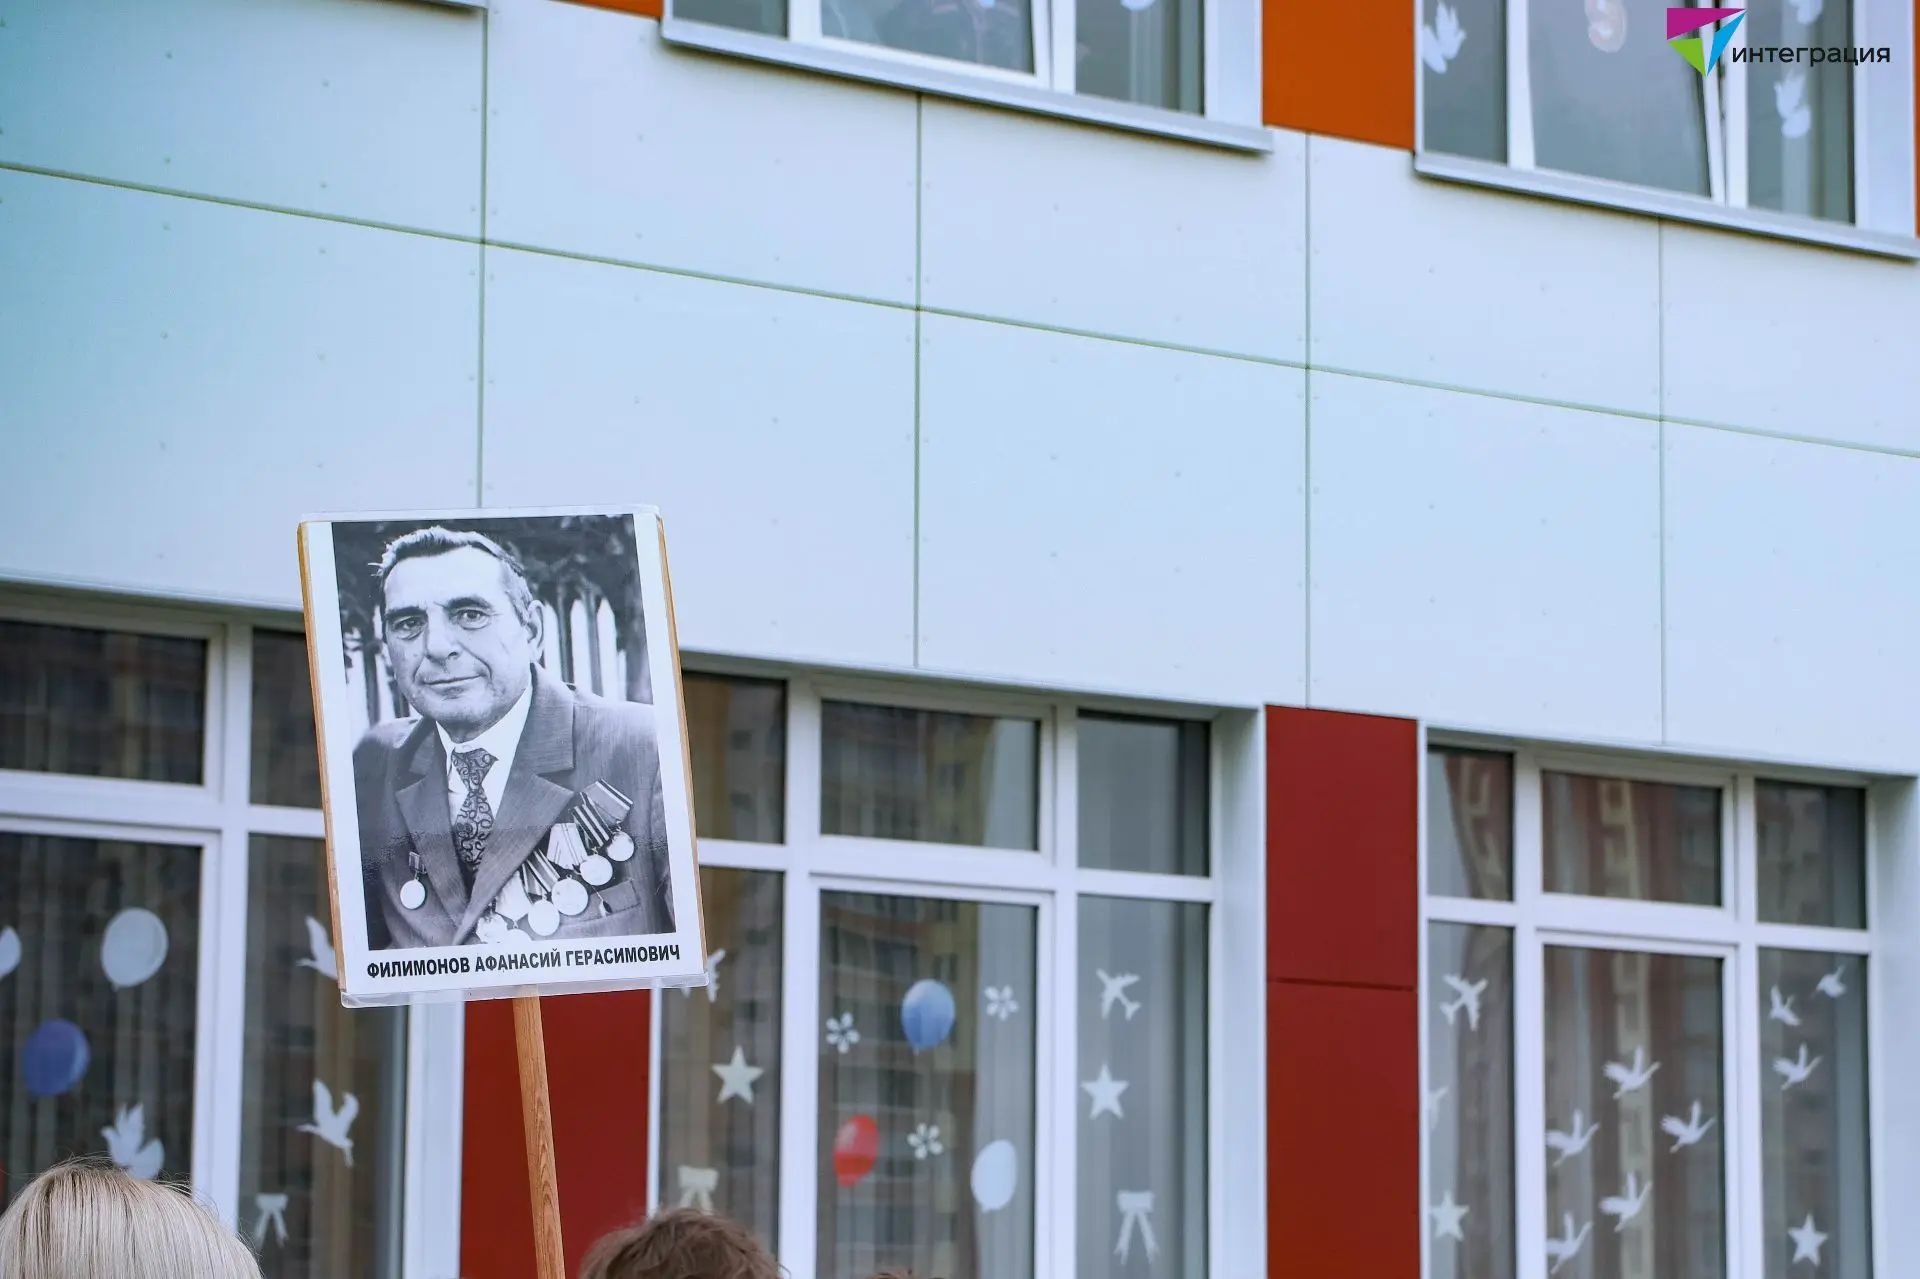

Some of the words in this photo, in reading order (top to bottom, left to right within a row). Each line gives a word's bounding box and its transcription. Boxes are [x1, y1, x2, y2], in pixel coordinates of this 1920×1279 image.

[367, 957, 471, 979] ФИЛИМОНОВ
[475, 948, 562, 973] АФАНАСИЙ
[566, 944, 681, 968] ГЕРАСИМОВИЧ
